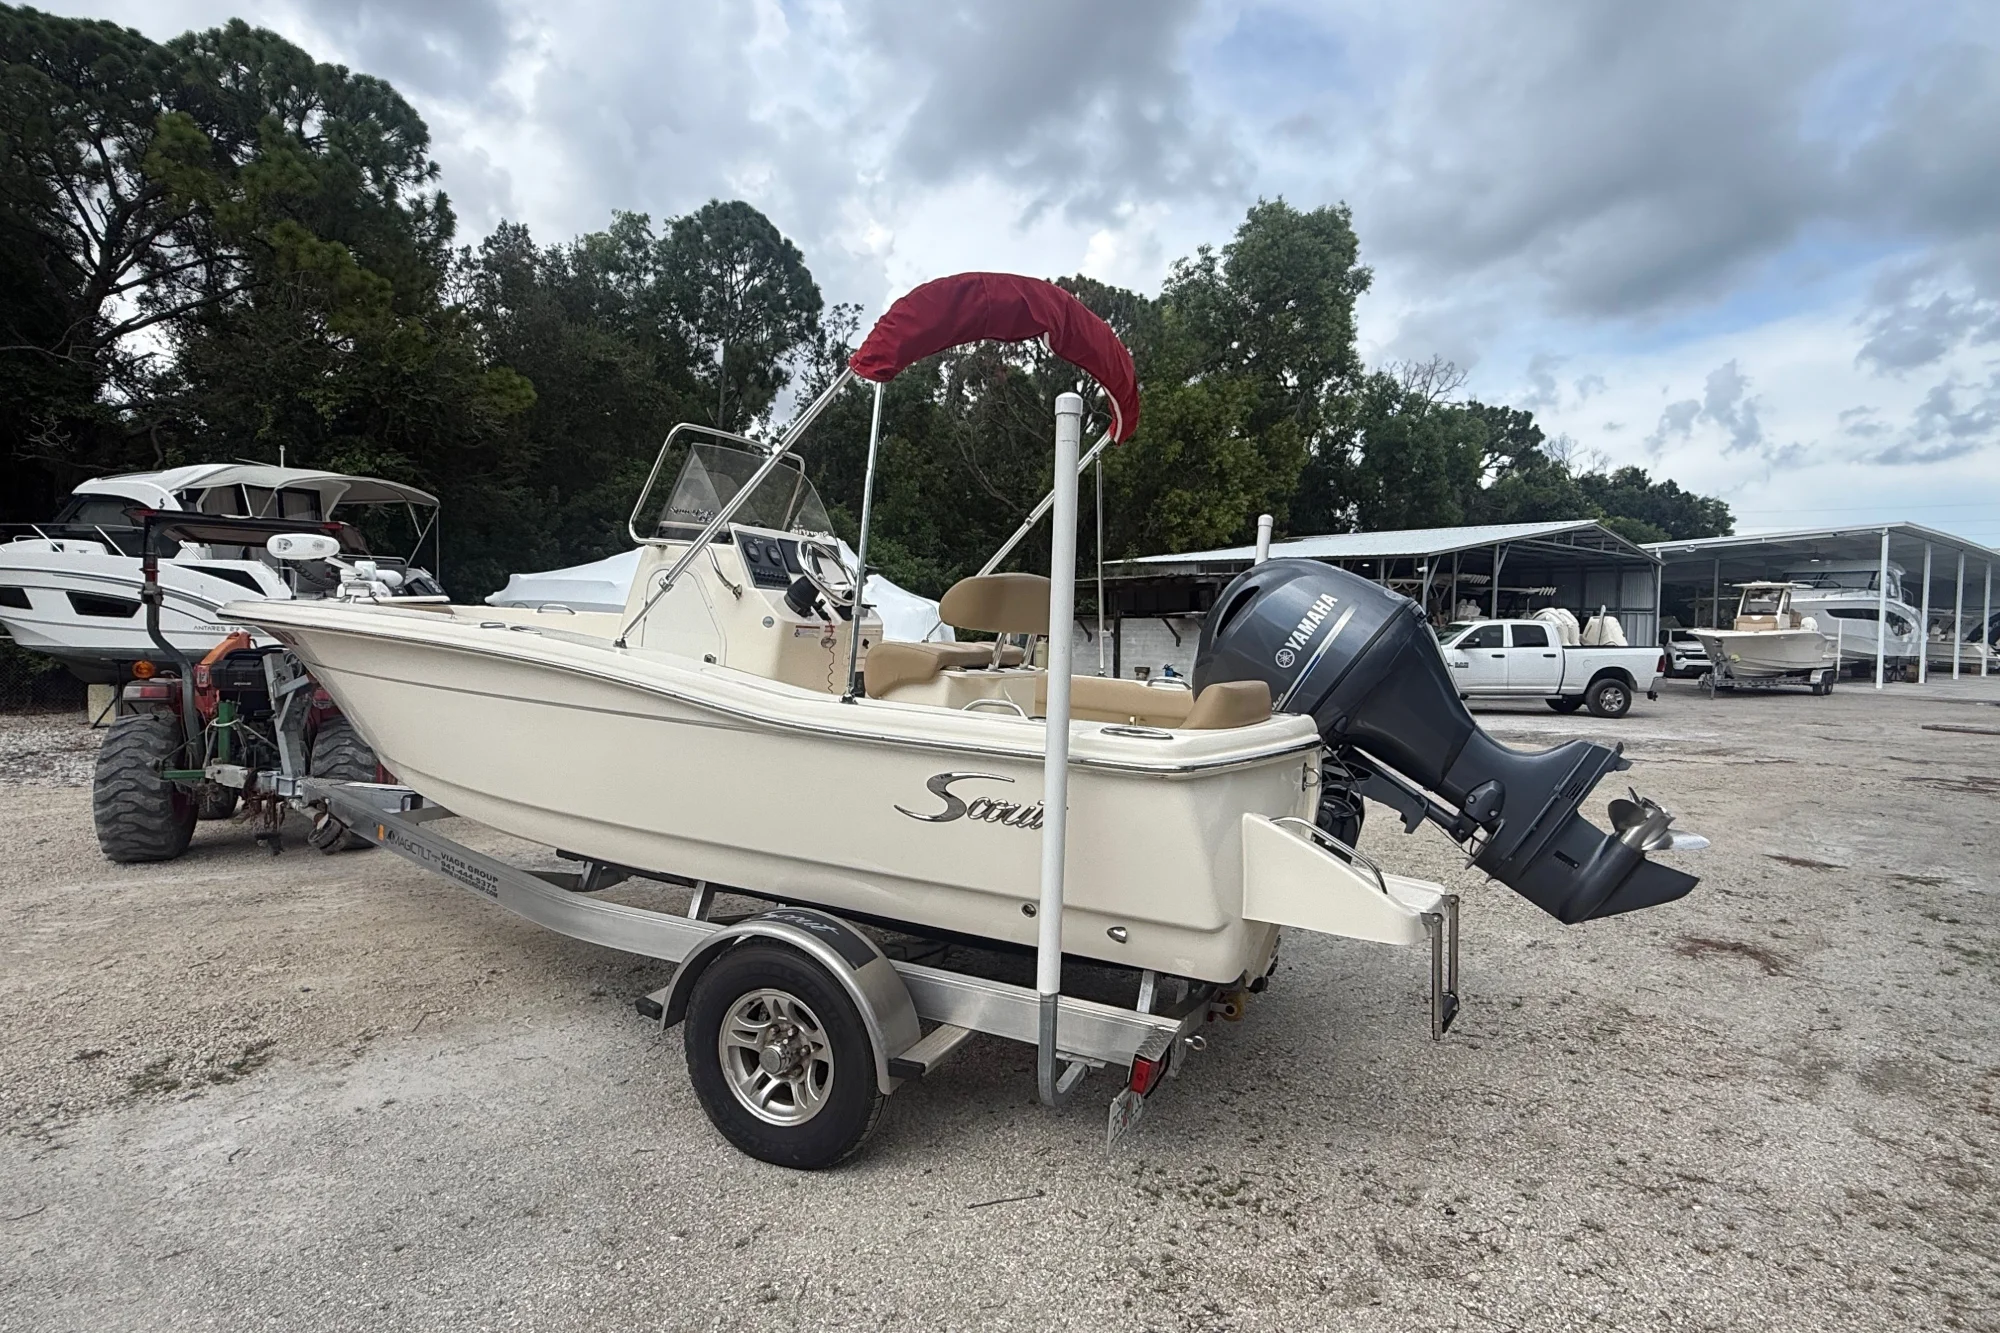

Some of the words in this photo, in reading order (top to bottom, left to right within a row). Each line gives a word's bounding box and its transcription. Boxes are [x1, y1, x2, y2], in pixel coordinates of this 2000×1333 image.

[1284, 593, 1338, 651] YAMAHA
[441, 852, 466, 870] VIAGE
[467, 865, 499, 884] GROUP
[441, 860, 498, 892] 941-444-5375
